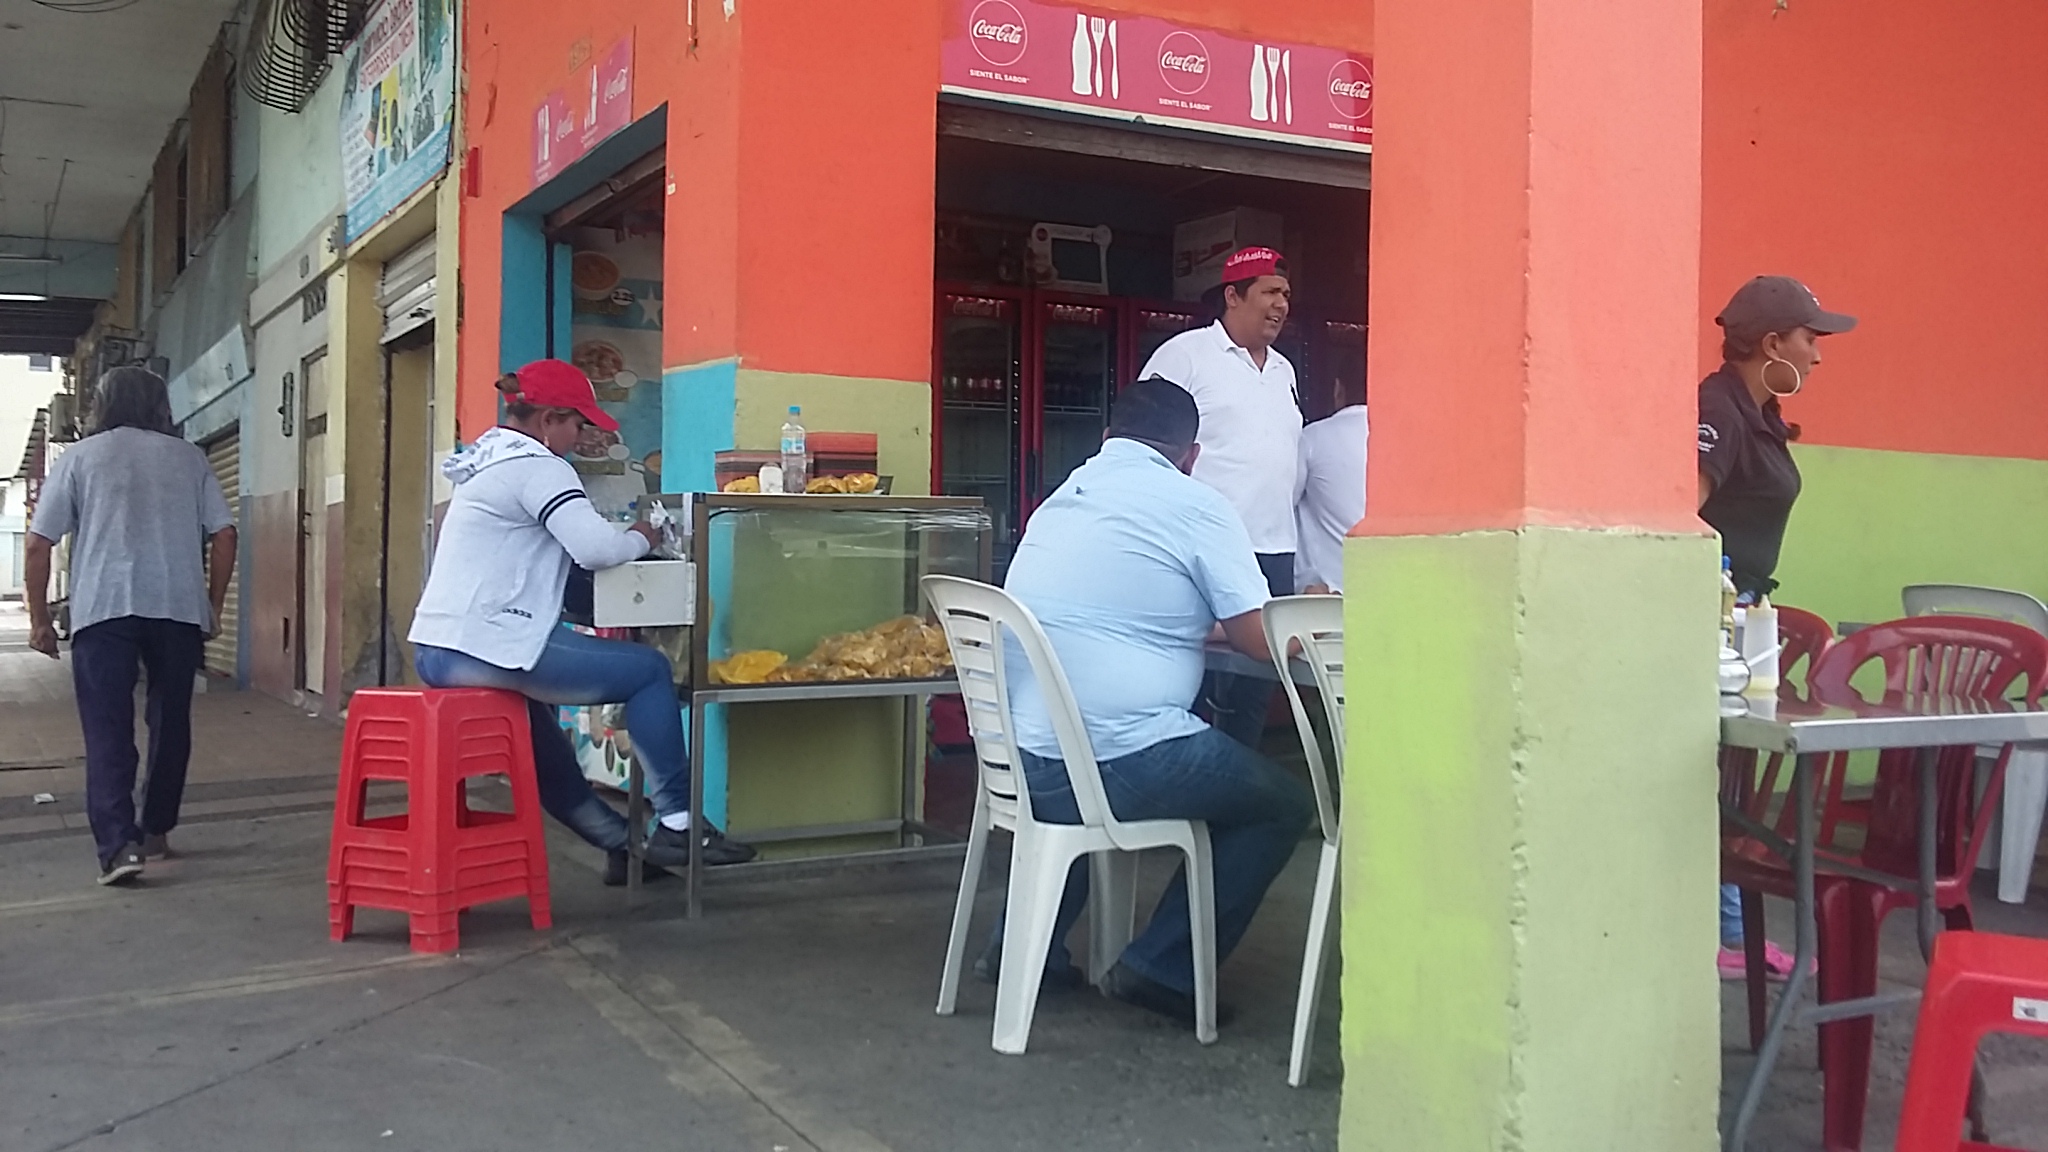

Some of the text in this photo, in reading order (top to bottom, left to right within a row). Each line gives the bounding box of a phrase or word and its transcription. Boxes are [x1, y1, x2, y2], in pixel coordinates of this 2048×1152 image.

[973, 19, 1023, 44] Coca-Cola
[1161, 51, 1207, 75] Coca-Cola
[969, 69, 1027, 84] SIENTE EL SABOR
[1158, 97, 1180, 107] SIENTE
[1181, 100, 1189, 109] EL
[1328, 122, 1348, 131] SIENTE
[1356, 126, 1372, 134] SABO
